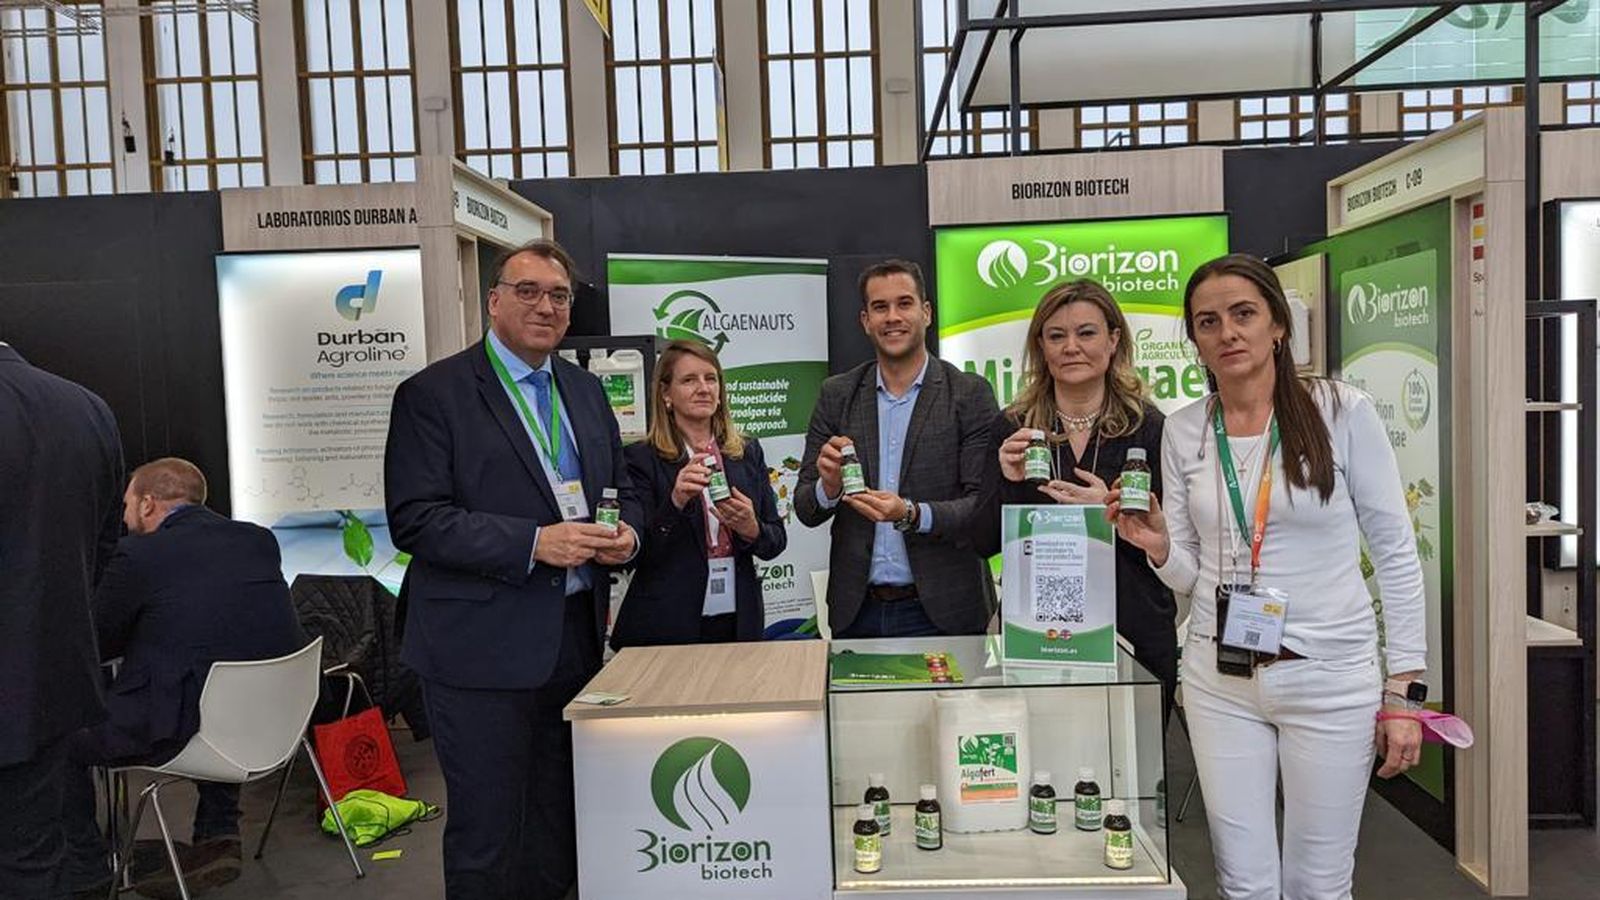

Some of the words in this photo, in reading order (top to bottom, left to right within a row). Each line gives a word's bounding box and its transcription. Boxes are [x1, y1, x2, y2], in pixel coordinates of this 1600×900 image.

[1011, 181, 1071, 200] BIORIZON
[1075, 178, 1130, 197] BIOTECH
[1346, 189, 1372, 213] BIORIZON
[1372, 178, 1398, 202] BIOTECH
[1406, 167, 1423, 189] C-09
[466, 195, 490, 221] BIORIZON
[256, 208, 351, 229] LABORATORIOS
[354, 207, 406, 226] DURBAN
[1032, 238, 1179, 286] Biorizon
[1102, 273, 1179, 292] biotech
[1367, 281, 1429, 323] Biorizon
[702, 312, 796, 331] ALGAENAUTS
[1393, 306, 1430, 328] biotech
[316, 328, 406, 347] Durban
[337, 371, 367, 379] science
[725, 379, 738, 391] nd
[738, 378, 790, 391] sustainable
[730, 391, 788, 407] biopesticides
[767, 405, 782, 417] via
[746, 417, 788, 433] approach
[763, 577, 795, 591] otech
[635, 828, 772, 873] Biorizon
[701, 862, 773, 880] biotech
